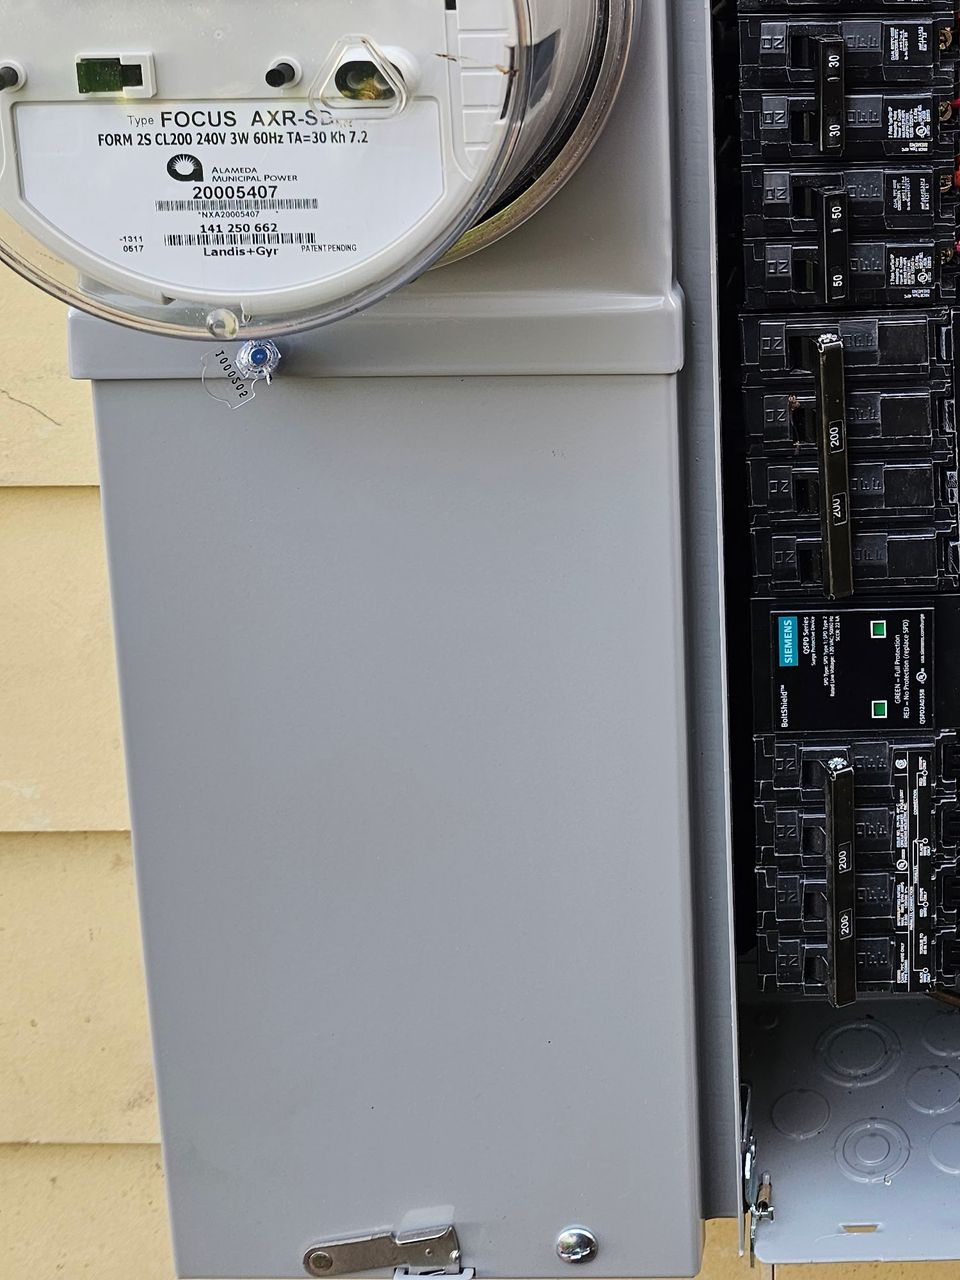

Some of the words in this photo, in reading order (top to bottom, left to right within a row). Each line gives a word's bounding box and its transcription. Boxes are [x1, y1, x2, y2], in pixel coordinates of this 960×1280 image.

[762, 36, 785, 50] ON
[828, 55, 840, 68] 30
[127, 115, 154, 127] Type
[160, 110, 236, 128] FOCUS
[762, 110, 785, 124] ON
[829, 124, 841, 138] 30
[98, 133, 133, 147] FORM
[137, 133, 152, 146] 2S
[155, 133, 193, 146] CL200
[196, 132, 227, 146] 240V
[230, 132, 249, 145] 3W
[253, 132, 284, 145] 60Hz
[287, 131, 327, 145] TA=30
[330, 131, 346, 144] Kh
[349, 131, 368, 144] 7.2
[211, 166, 258, 174] ALAMEDA
[211, 174, 262, 182] MUNICIPAL
[263, 173, 298, 182] POWER
[192, 185, 278, 200] 20005407
[765, 186, 787, 200] ON
[831, 206, 842, 219] 50
[200, 224, 223, 234] 141
[227, 223, 251, 233] 250
[254, 223, 278, 233] 662
[203, 246, 279, 257] Landis+Gyr
[301, 245, 326, 253] PATENT
[327, 244, 357, 253] PENDING
[766, 260, 789, 274] ON
[832, 274, 843, 287] 50
[829, 426, 840, 448] 200
[832, 497, 842, 519] 200
[902, 619, 910, 633] SPD)
[784, 619, 793, 664] SIEMENS
[802, 636, 810, 655] QSPD
[902, 633, 910, 659] (replace
[903, 691, 910, 701] No
[780, 684, 789, 728] BoltShield™
[838, 850, 848, 870] 200
[841, 914, 850, 936] 200
